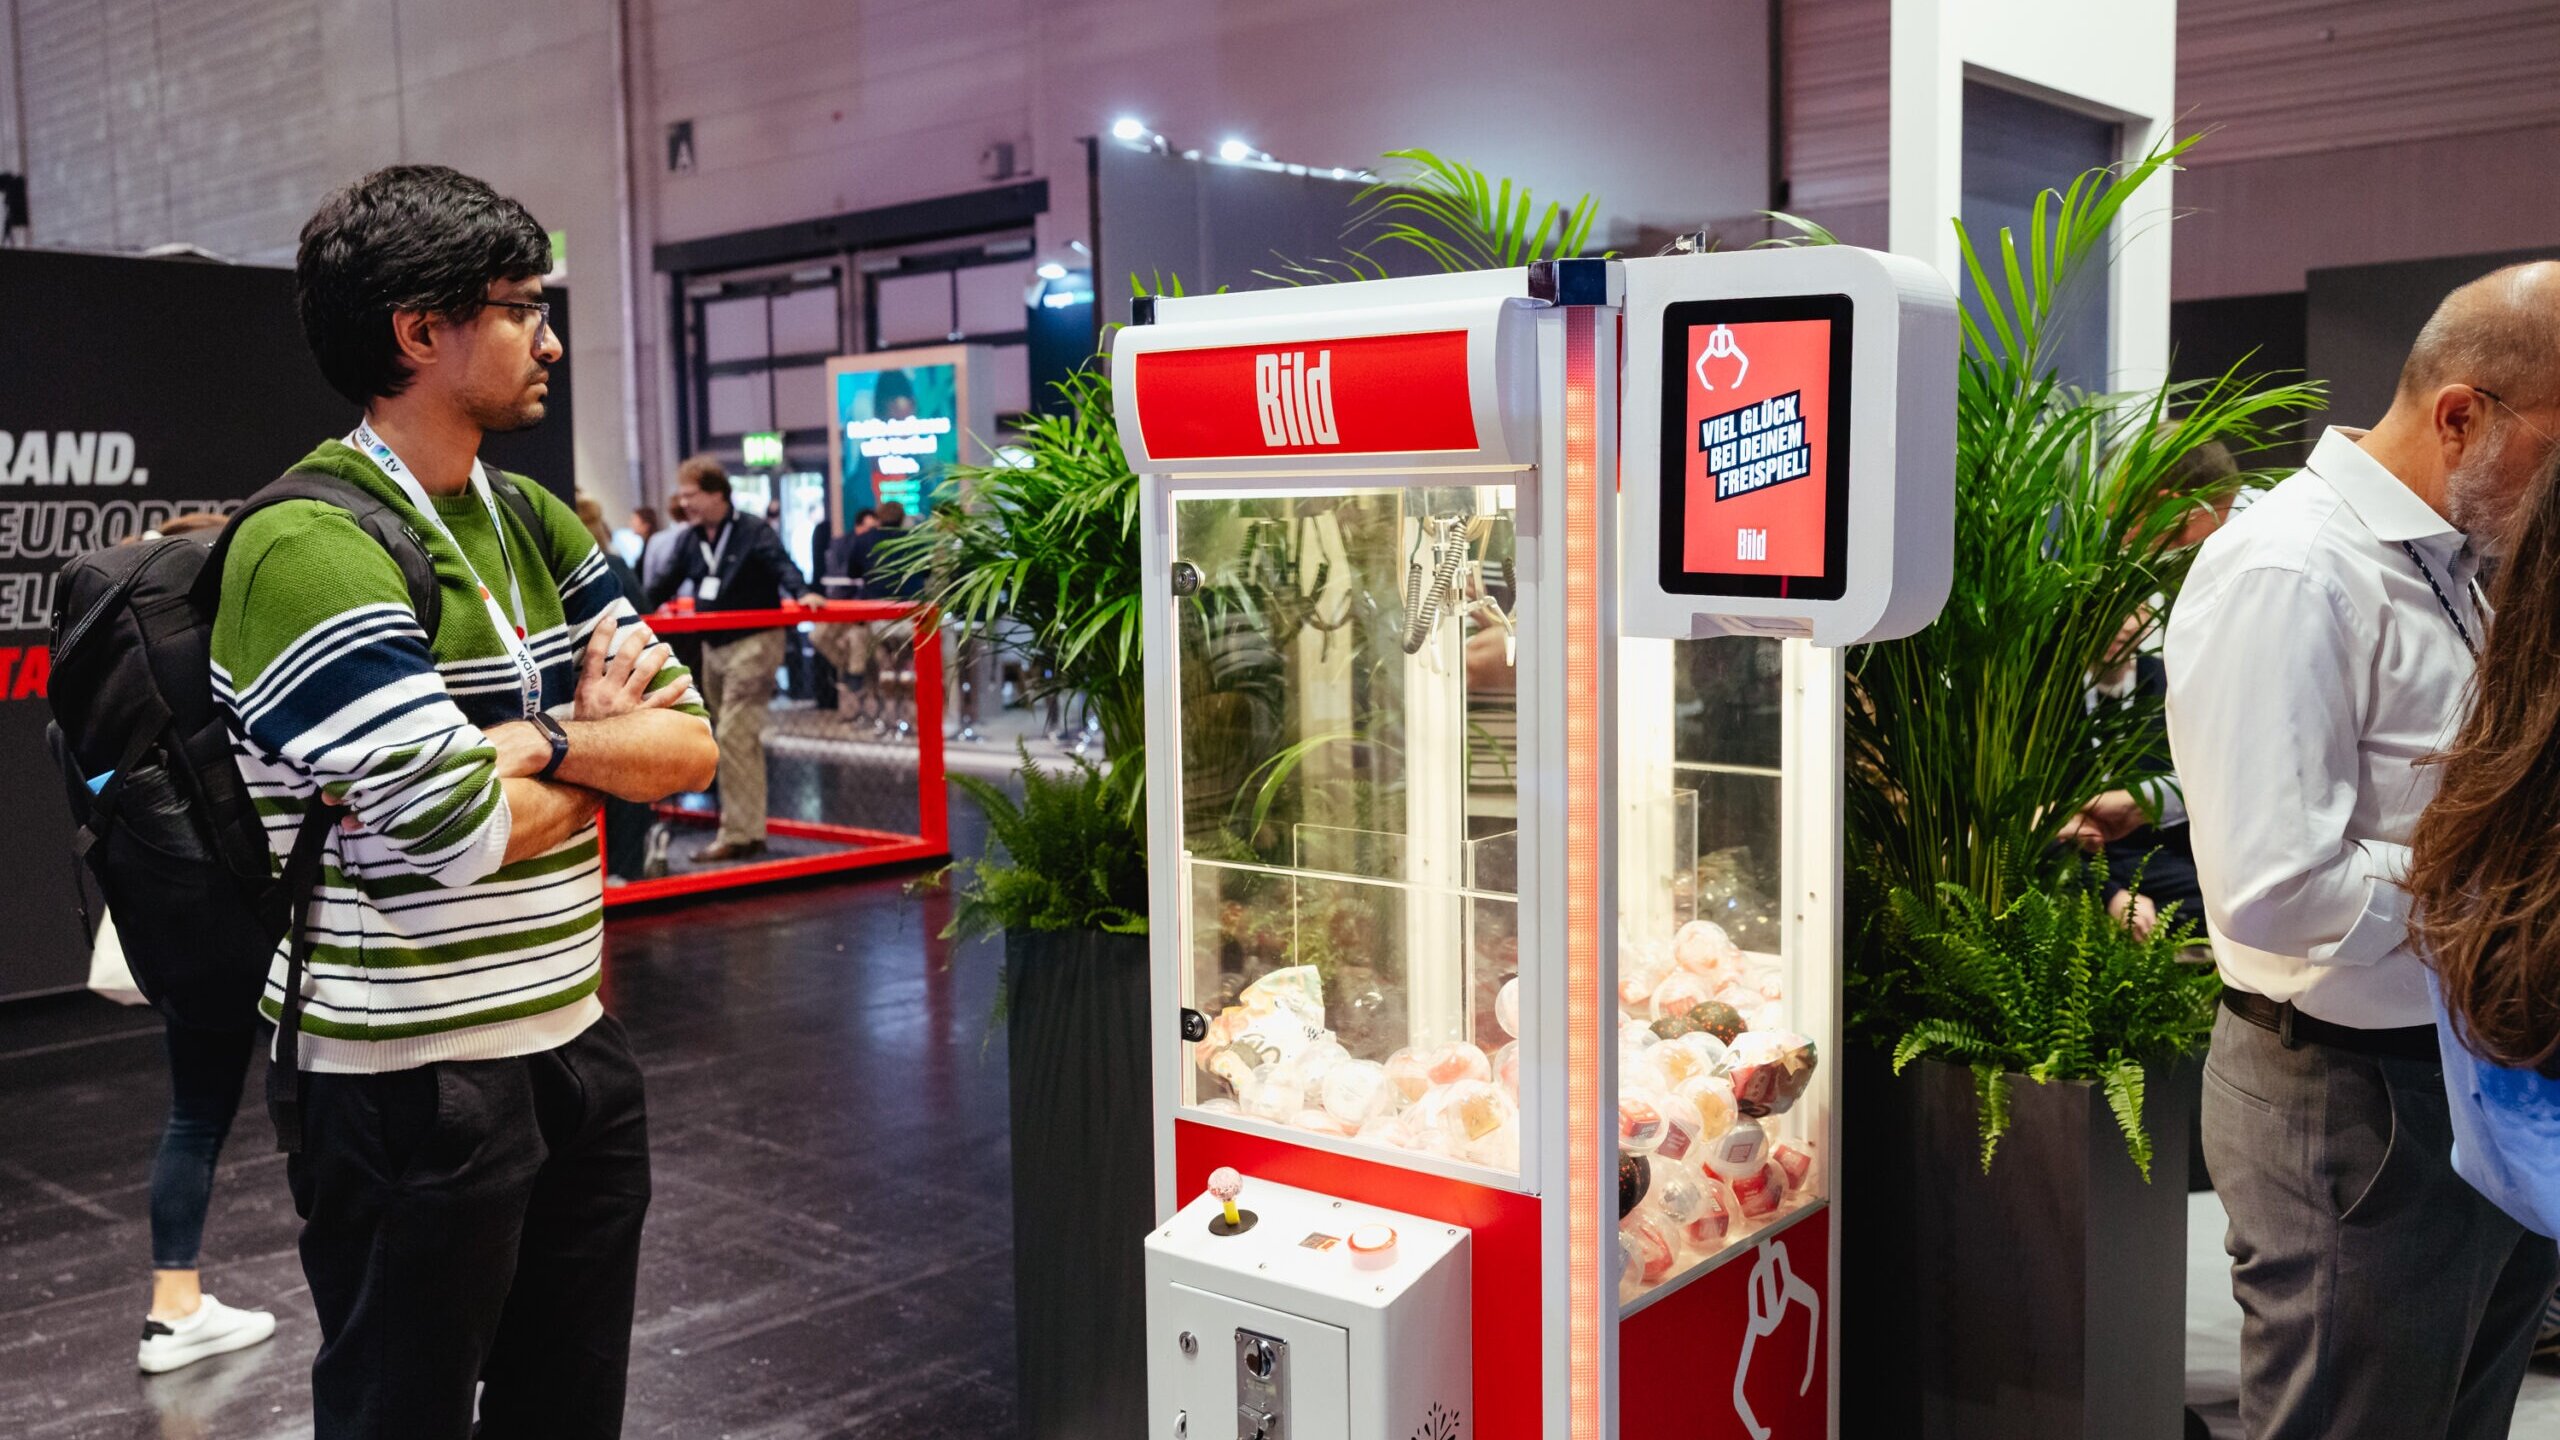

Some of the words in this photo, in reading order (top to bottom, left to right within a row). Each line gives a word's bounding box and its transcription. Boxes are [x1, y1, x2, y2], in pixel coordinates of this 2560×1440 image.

[1255, 350, 1340, 447] Bild
[1702, 414, 1738, 448] VIEL
[1740, 394, 1798, 436] GLÜCK
[1710, 445, 1737, 473] BEI
[1740, 421, 1803, 465] DEINEM
[1718, 447, 1809, 498] FREISPIEL!
[1737, 528, 1767, 561] Bild
[518, 651, 538, 690] waipu
